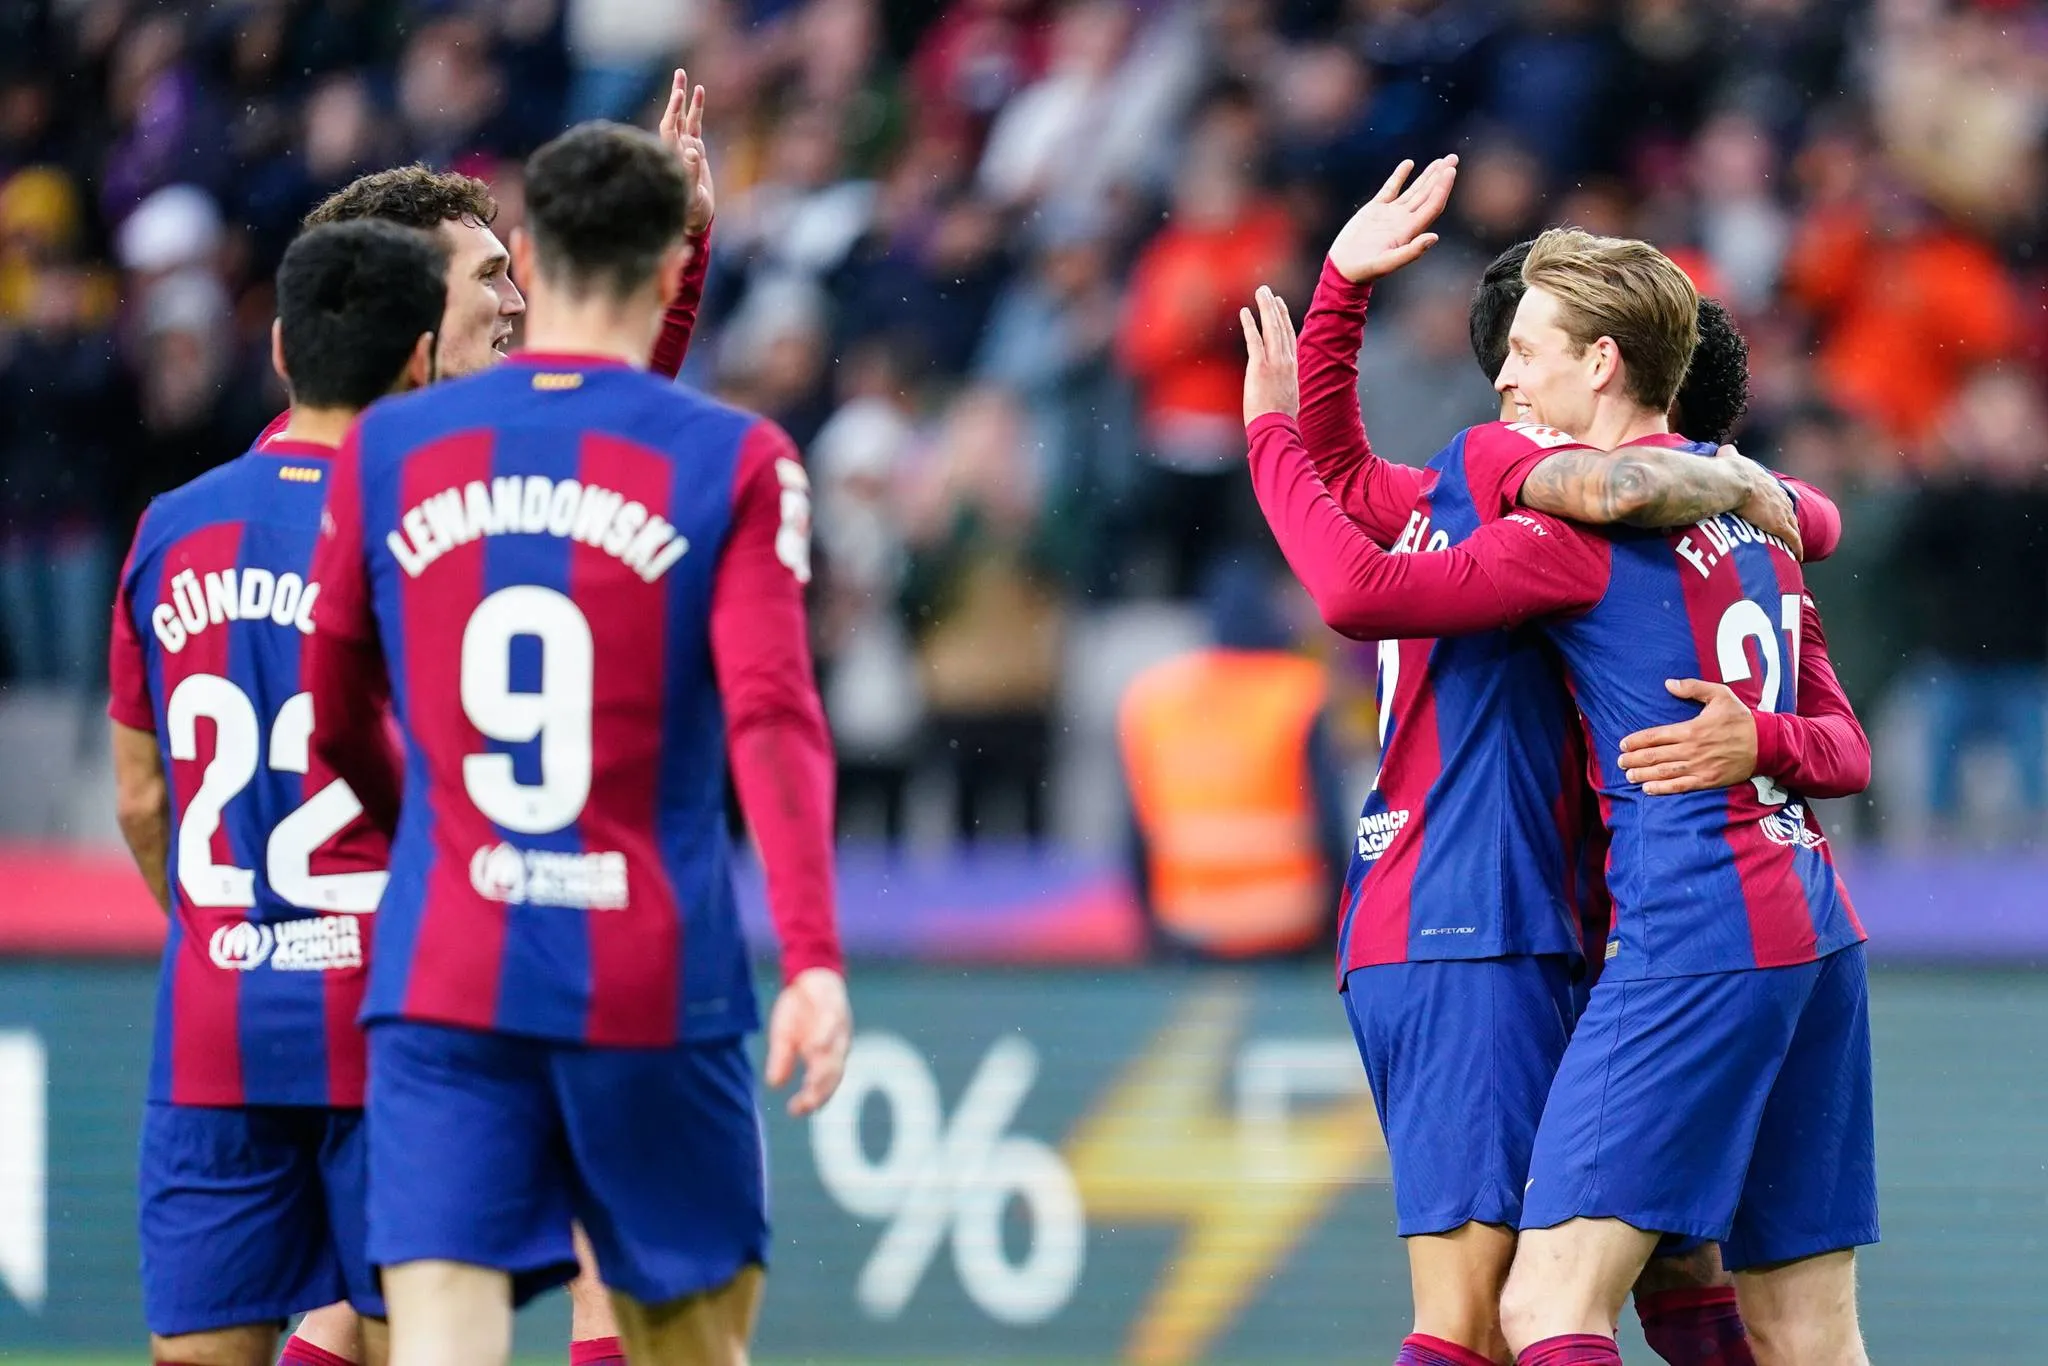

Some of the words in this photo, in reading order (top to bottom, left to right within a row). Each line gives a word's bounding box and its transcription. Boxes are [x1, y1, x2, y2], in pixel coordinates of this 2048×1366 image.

[386, 475, 690, 584] LEWANDOWSKI
[168, 673, 390, 913] 22
[461, 586, 592, 834] 9
